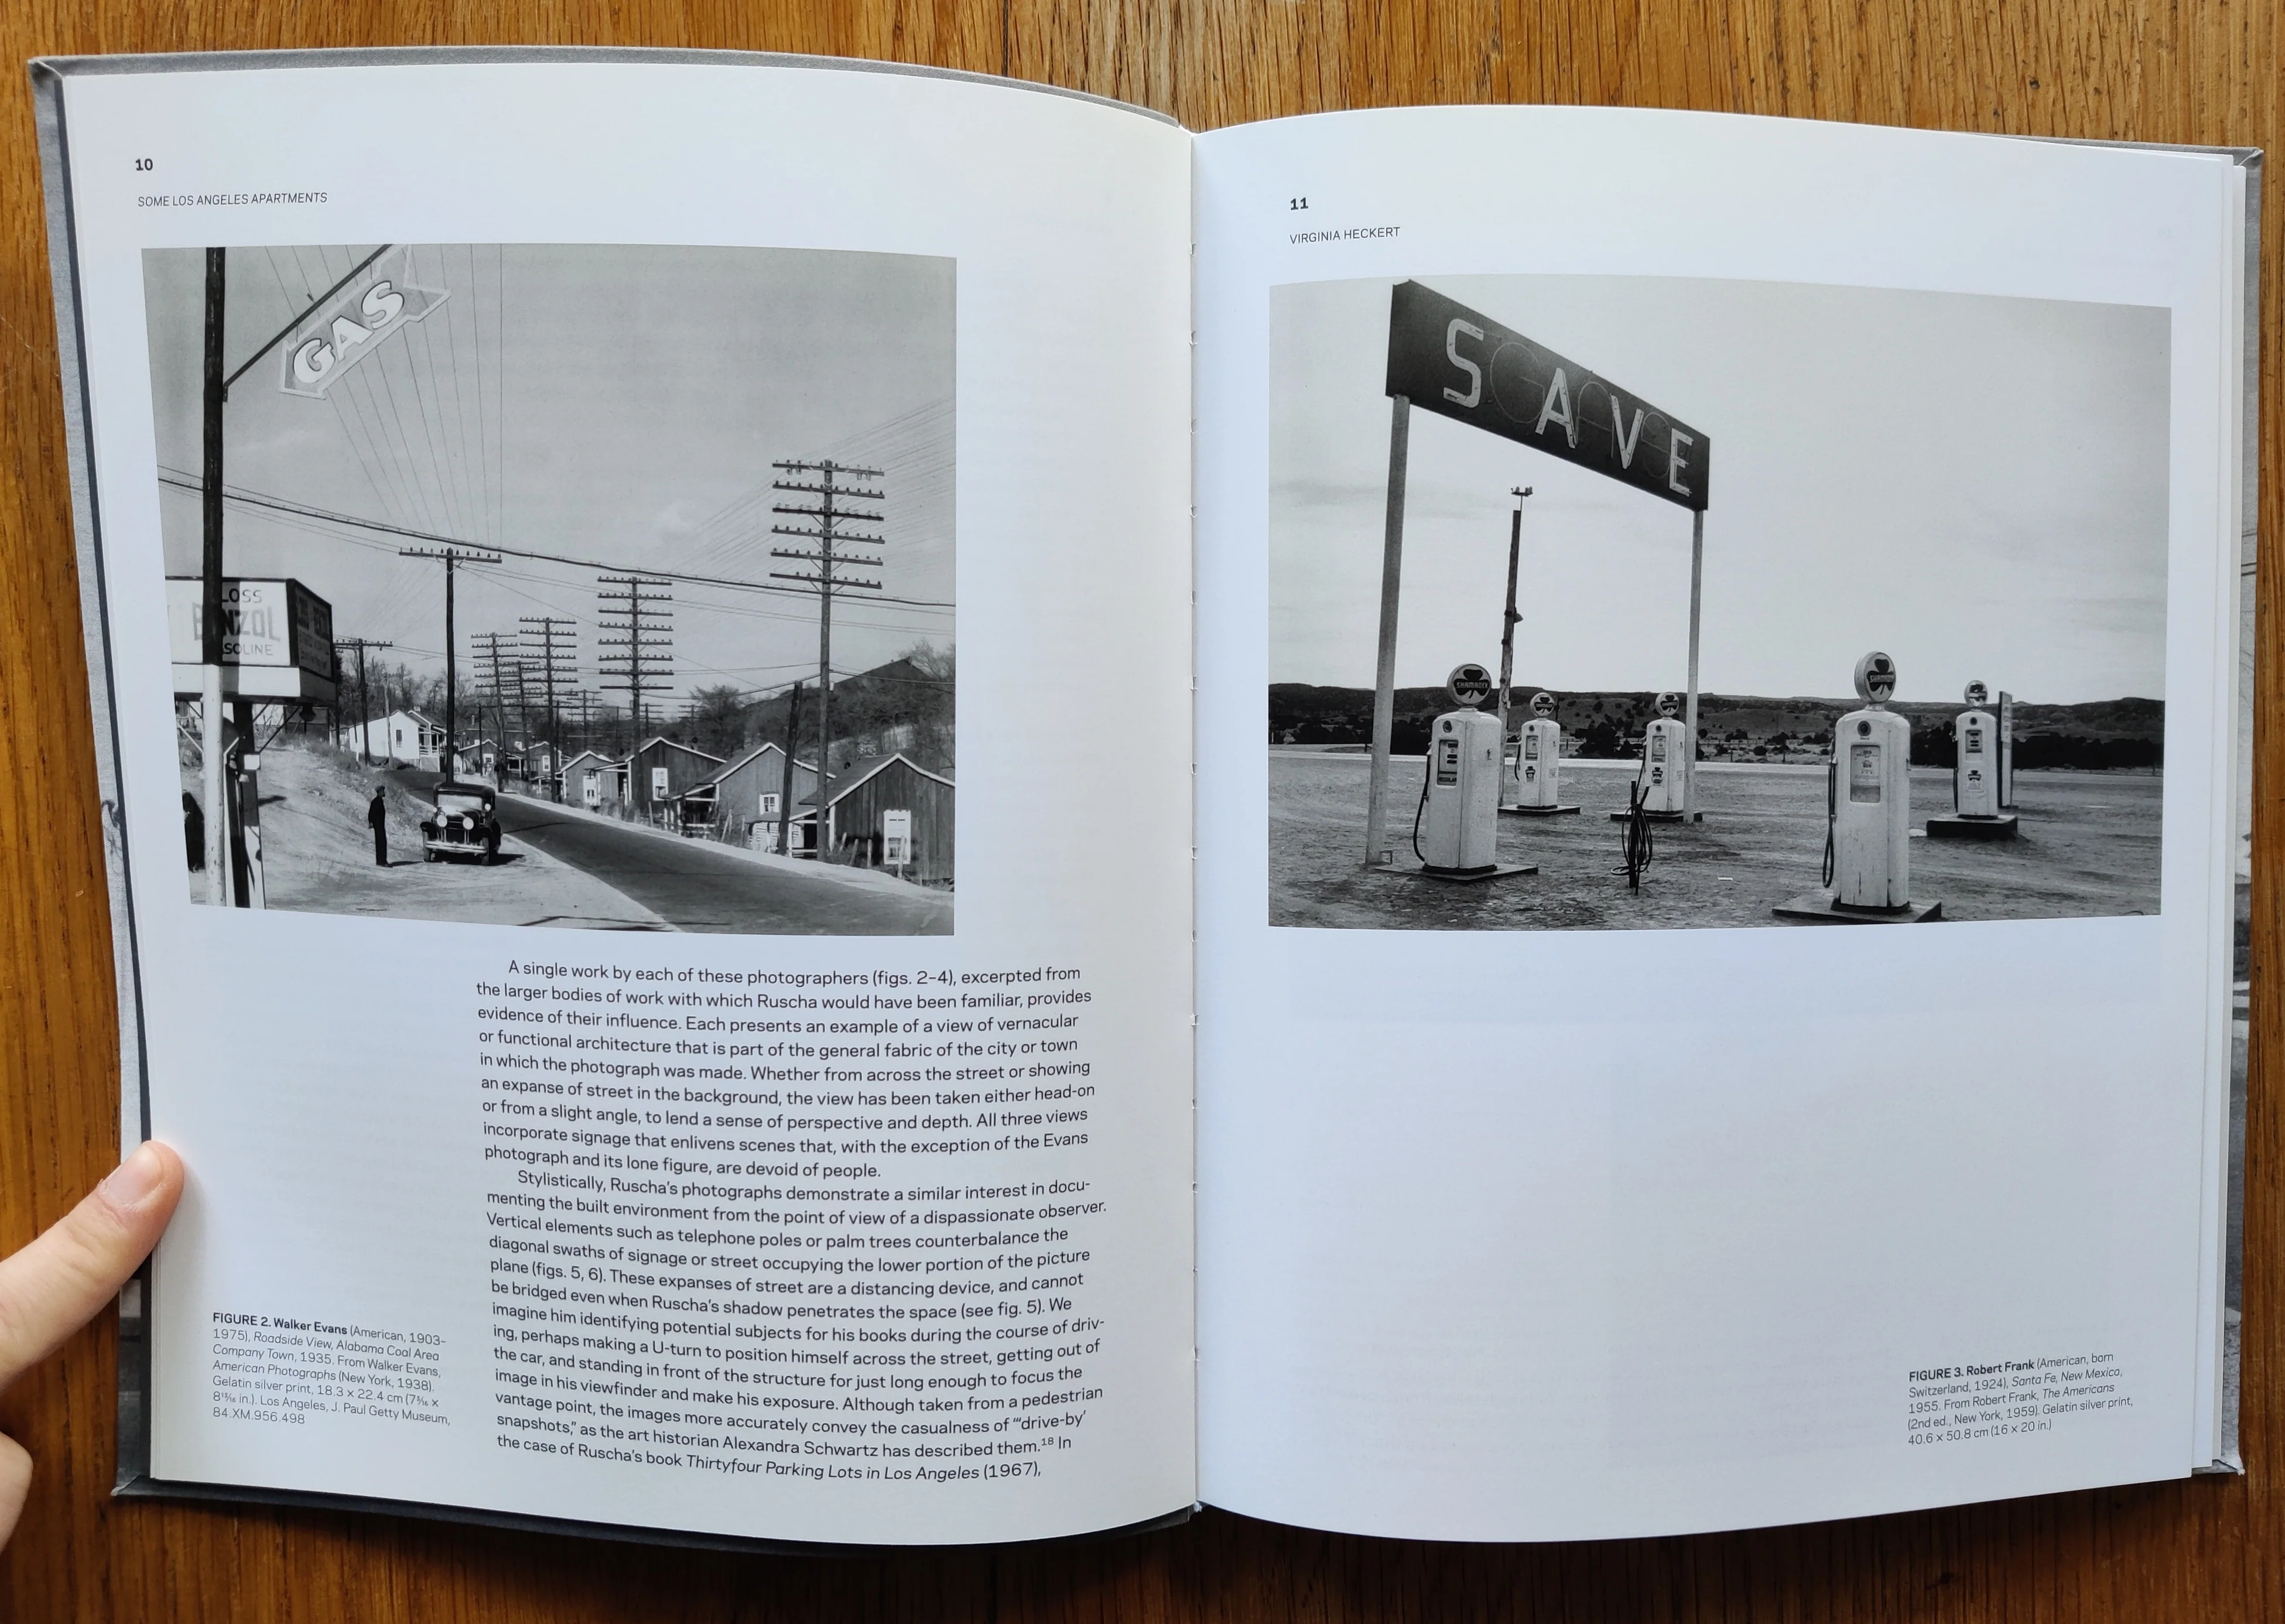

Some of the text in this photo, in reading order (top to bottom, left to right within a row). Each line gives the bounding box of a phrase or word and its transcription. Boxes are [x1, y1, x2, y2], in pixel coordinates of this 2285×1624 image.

[135, 158, 153, 171] 10
[138, 192, 327, 207] SOME LOS ANGELES APARTMENTS
[1290, 197, 1309, 211] 11
[1289, 227, 1401, 244] VIRGINIA HECKERT
[293, 281, 405, 384] GAS
[1443, 318, 1694, 498] SAVE
[192, 602, 281, 642] BNZOL
[508, 960, 520, 974] A
[524, 961, 567, 979] single
[571, 964, 609, 979] work
[613, 965, 632, 983] by
[635, 967, 673, 981] each
[678, 967, 694, 982] of
[697, 968, 743, 983] these
[748, 969, 868, 988] photographers
[873, 970, 912, 988] (figs.
[962, 967, 1041, 986] excerpted
[1045, 966, 1080, 981] from
[480, 1052, 1090, 1082] in which the photograph was made. Whether from across the street or showing
[518, 1170, 606, 1193] Stylistically,
[682, 1182, 782, 1202] photographs
[786, 1185, 890, 1201] demonstrate
[894, 1191, 903, 1201] a
[908, 1186, 962, 1201] similar
[966, 1184, 1027, 1199] interest
[1032, 1182, 1044, 1196] in
[1049, 1179, 1090, 1194] docu-
[491, 1257, 1083, 1298] plane (figs. 5, 6). These expanses of street are a distancing device, and cannot
[213, 1312, 258, 1326] FIGURE
[261, 1317, 272, 1327] 2.
[273, 1317, 312, 1331] Walker
[314, 1321, 348, 1335] Evans
[350, 1325, 406, 1343] (American,
[213, 1328, 439, 1361] 1975), Roadside View, Alabama Coal Area
[213, 1343, 441, 1378] Company Town, 1935. From Walker Evans,
[213, 1359, 435, 1393] American Photographs (New York, 1938).
[1909, 1352, 2113, 1382] FIGURE 3. Robert Frank (American, born
[213, 1375, 252, 1389] Gelatin
[255, 1379, 283, 1391] silver
[286, 1383, 314, 1396] print,
[317, 1384, 344, 1397] 18.3
[357, 1389, 385, 1401] 22.4
[387, 1394, 403, 1403] cm
[495, 1368, 1103, 1414] image in his viewfinder and make his exposure. Although taken from a pedestrian
[1909, 1367, 2122, 1398] Switzerland, 1924), Santa Fe, New Mexico,
[261, 1394, 279, 1406] Los
[282, 1397, 329, 1413] Angeles,
[331, 1401, 340, 1412] J.
[344, 1402, 365, 1415] Paul
[369, 1405, 399, 1421] Getty
[402, 1408, 450, 1426] Museum,
[1908, 1396, 2133, 1431] (2nd ed., New York, 1959). Gelatin silver print,
[1909, 1384, 2115, 1414] 1955. From Robert Frank, The Americans
[213, 1407, 305, 1424] 84.XM.956.498
[1908, 1432, 1933, 1445] 40.6
[1947, 1428, 1971, 1441] 50.8
[1973, 1429, 1989, 1438] cm
[1991, 1424, 2008, 1437] (16
[2021, 1421, 2035, 1432] 20
[2038, 1418, 2051, 1431] in.)
